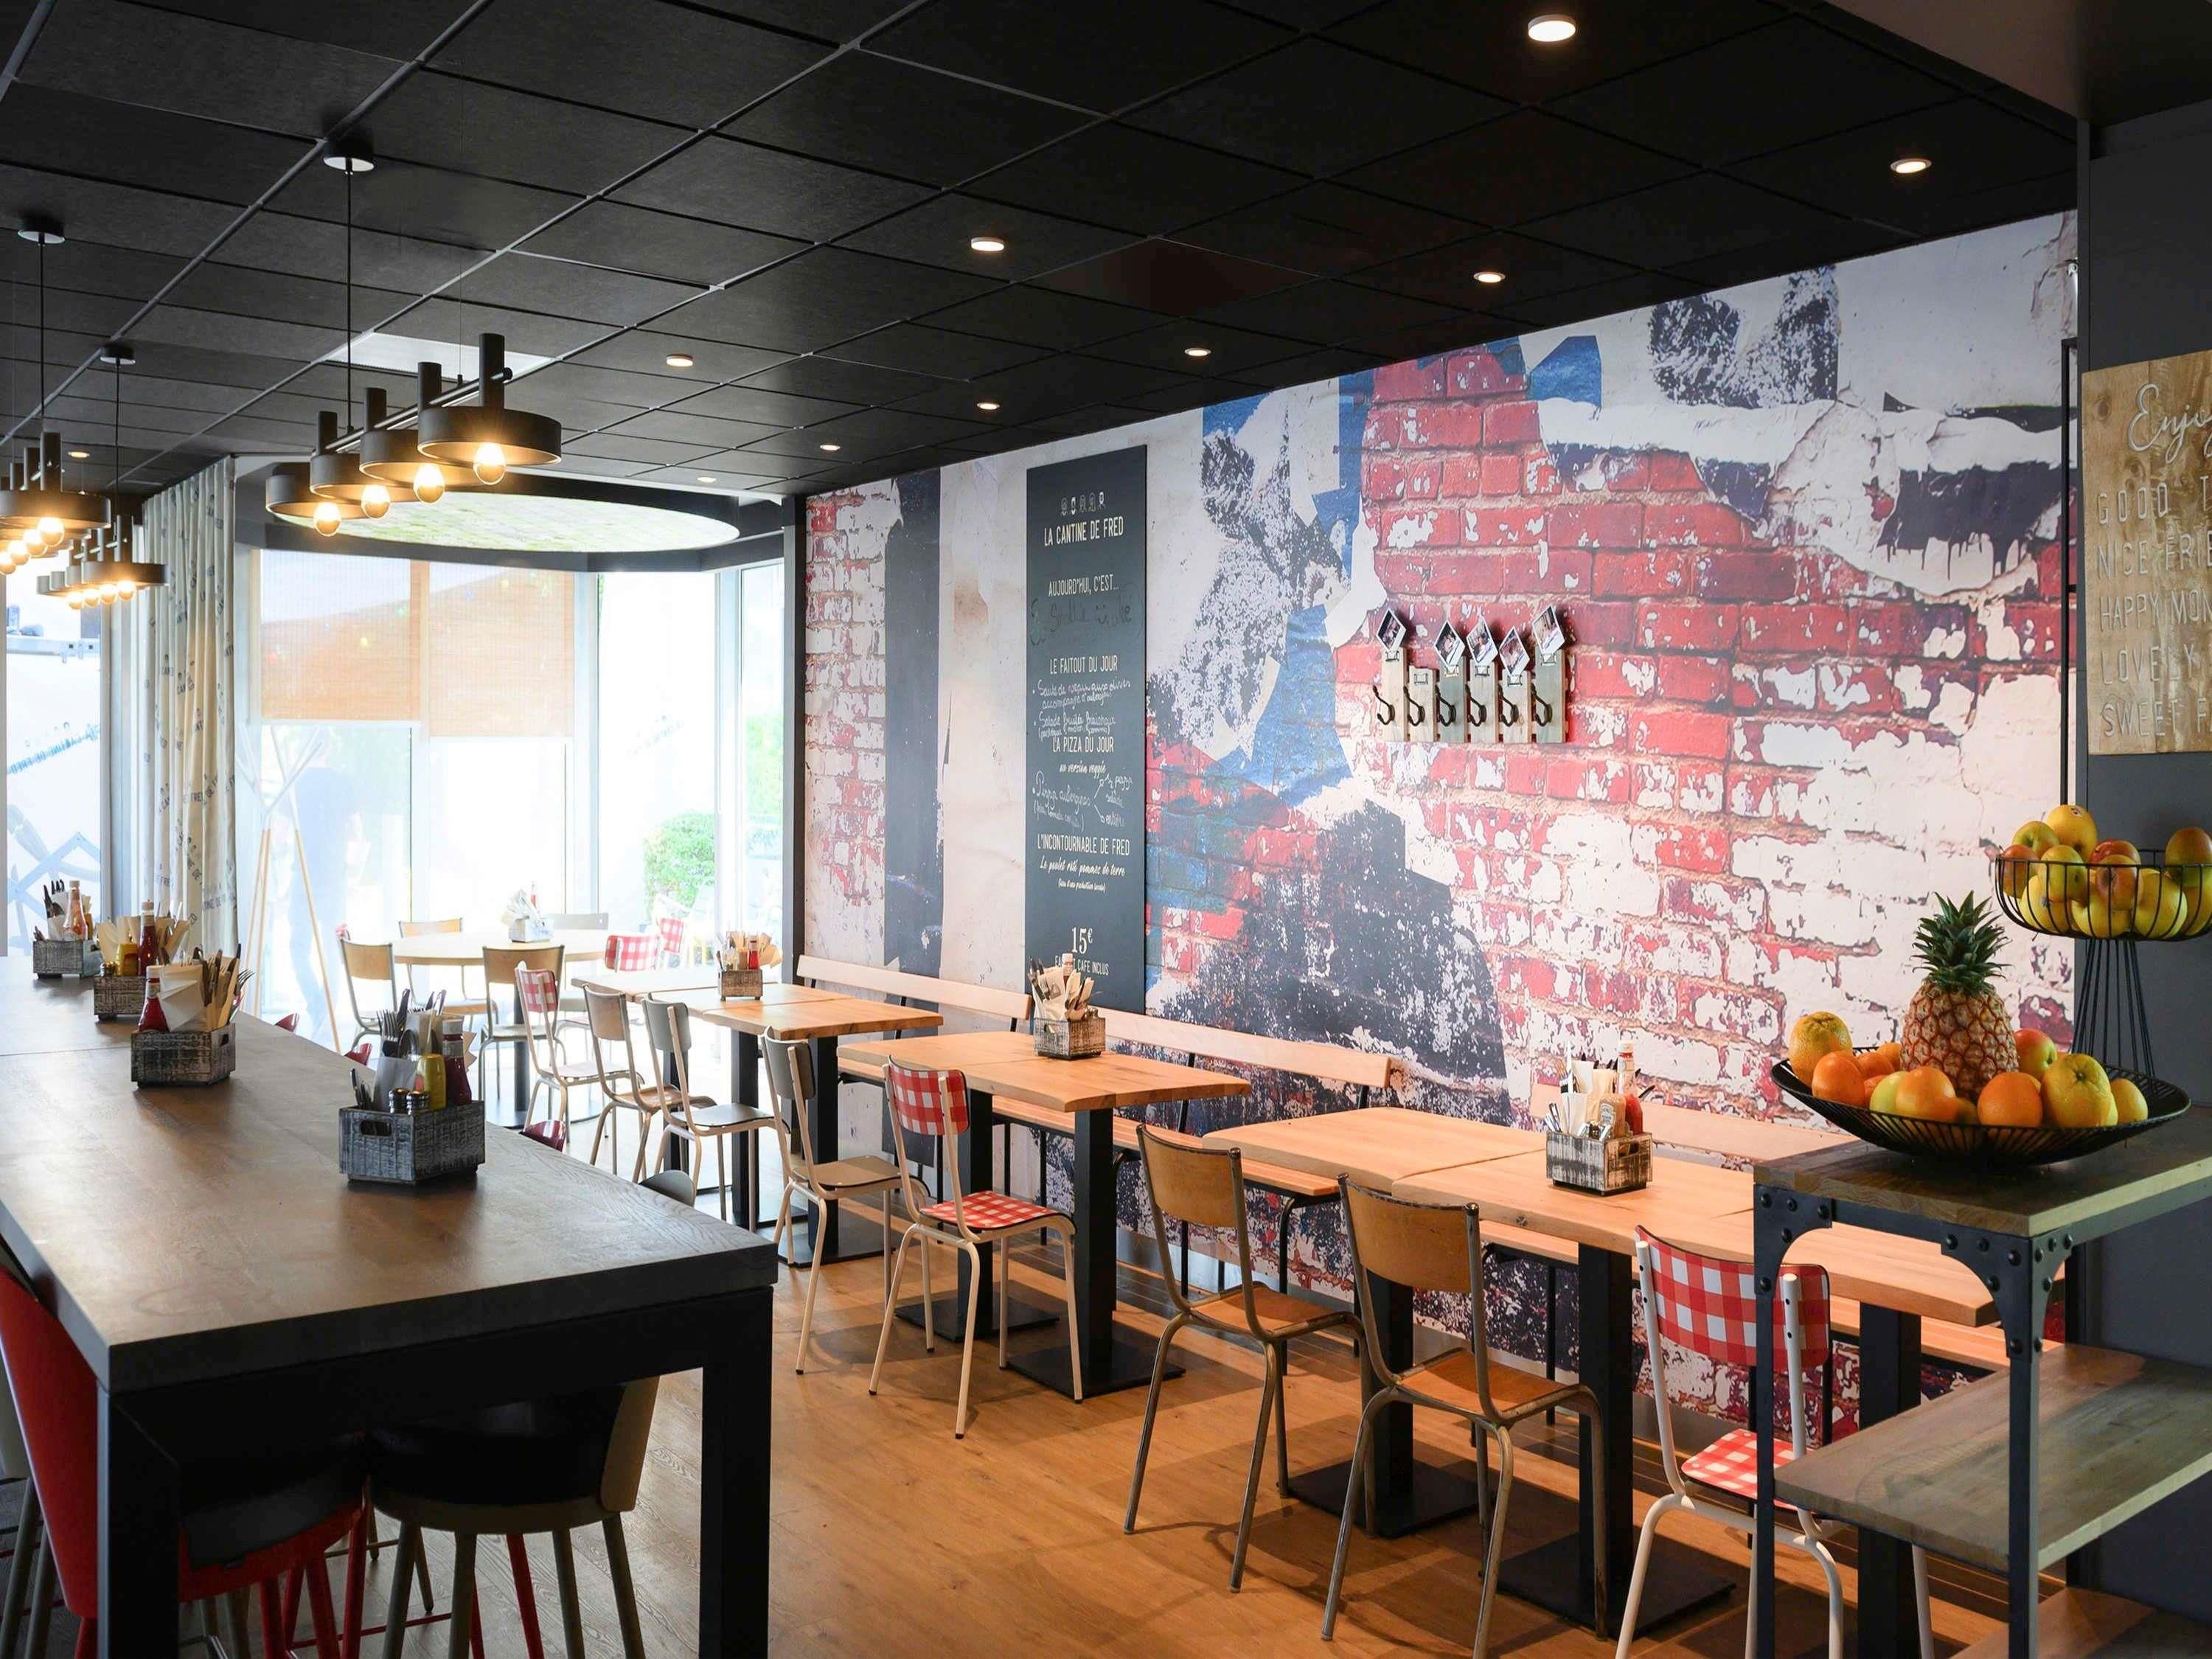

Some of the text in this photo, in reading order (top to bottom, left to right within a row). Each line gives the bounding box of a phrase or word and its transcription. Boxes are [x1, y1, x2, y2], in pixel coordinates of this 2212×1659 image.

[2128, 383, 2212, 464] Enjo
[2098, 482, 2168, 524] GOOD
[1044, 515, 1124, 546] LA CANTINE DE FRED
[2097, 539, 2149, 579] NICE
[1048, 573, 1119, 597] AUJOURD'HUI, C'EST...
[2100, 592, 2160, 632] HAPPY
[1050, 655, 1118, 675] LE FAITOUT DU JOUR
[2101, 643, 2194, 684] LOVELY
[2101, 697, 2212, 737] SWEET F
[1053, 736, 1114, 753] LA PIZZA DU JOUR
[1037, 833, 1130, 855] L'INCONTOURNABLE DE FRED
[1040, 855, 1047, 869] Le
[1048, 857, 1066, 873] poulet
[1078, 864, 1101, 876] pommes
[1102, 861, 1110, 874] de
[1110, 863, 1126, 877] terre
[1071, 927, 1093, 954] 15€
[1077, 959, 1091, 973] CAFE
[1092, 961, 1109, 976] INCLUS
